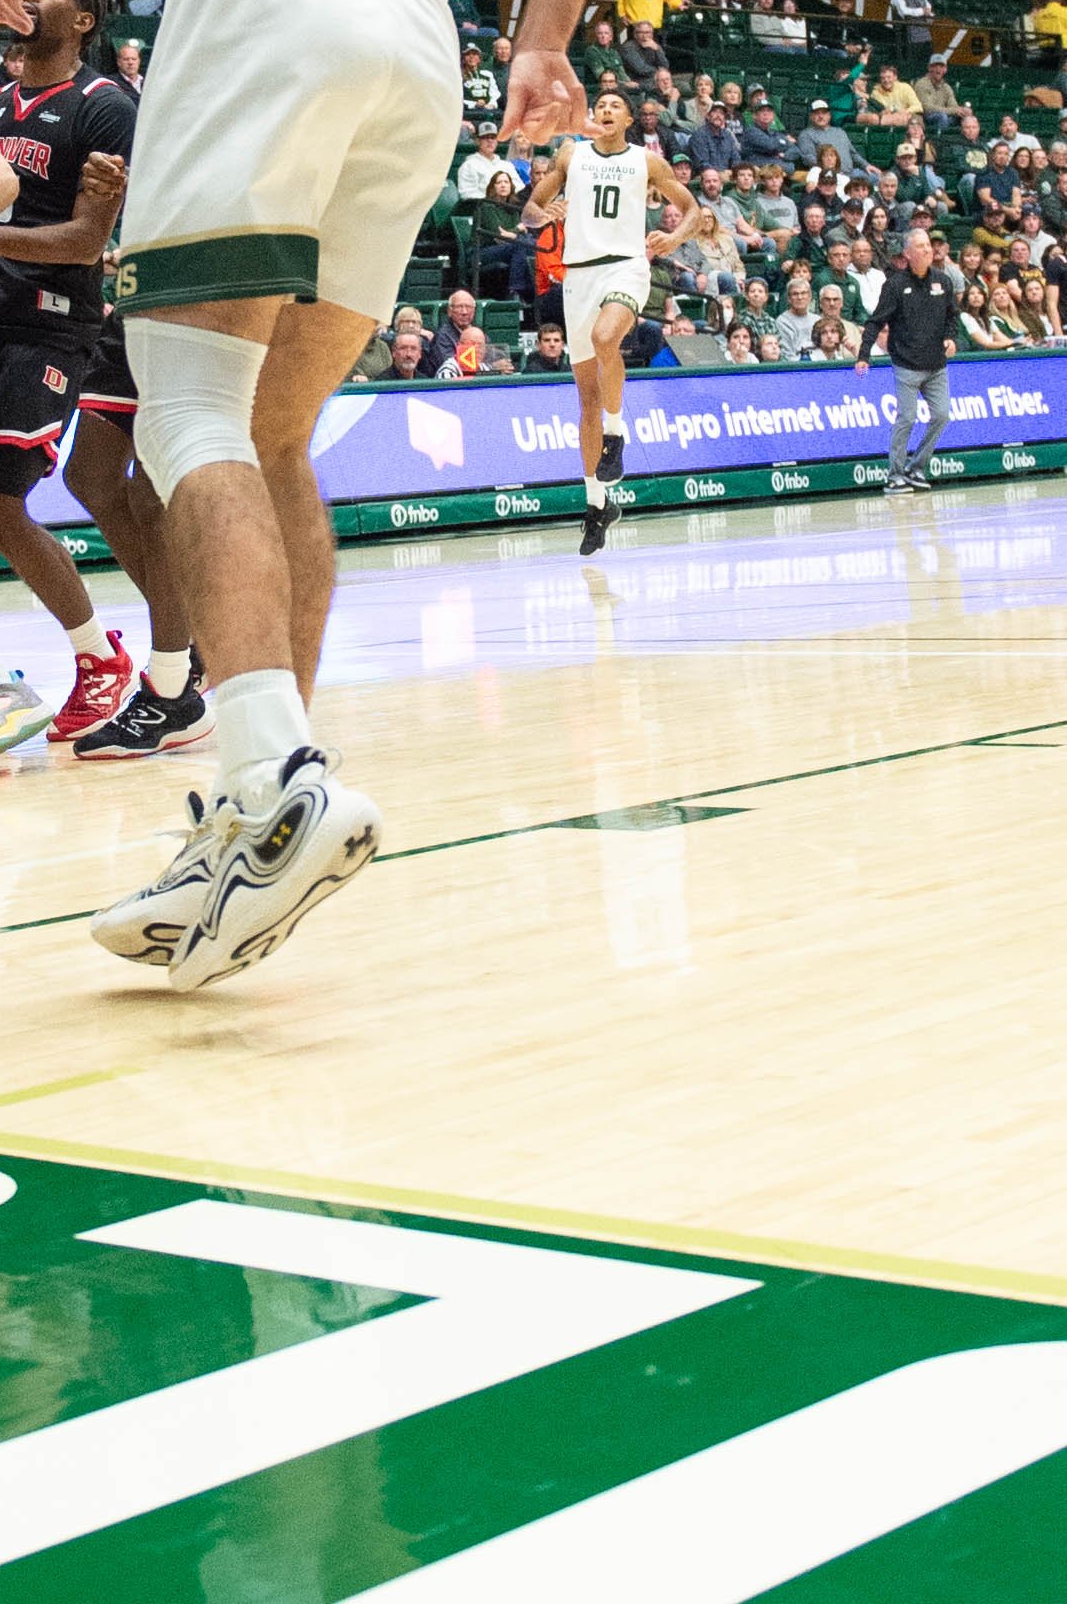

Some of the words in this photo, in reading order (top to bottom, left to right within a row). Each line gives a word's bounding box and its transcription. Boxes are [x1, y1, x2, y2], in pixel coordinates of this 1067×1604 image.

[593, 184, 620, 219] 10
[511, 414, 631, 453] Unle
[635, 407, 721, 449] all-pro
[721, 402, 824, 437] internet
[825, 394, 880, 429] with
[988, 385, 1049, 417] Fiber.
[942, 457, 965, 474] fnbo
[1014, 452, 1036, 468] fnbo
[699, 479, 725, 498] fnbo
[784, 472, 810, 490] fnbo
[407, 504, 439, 524] fnbo
[511, 495, 540, 514] fnbo
[62, 535, 89, 555] bo
